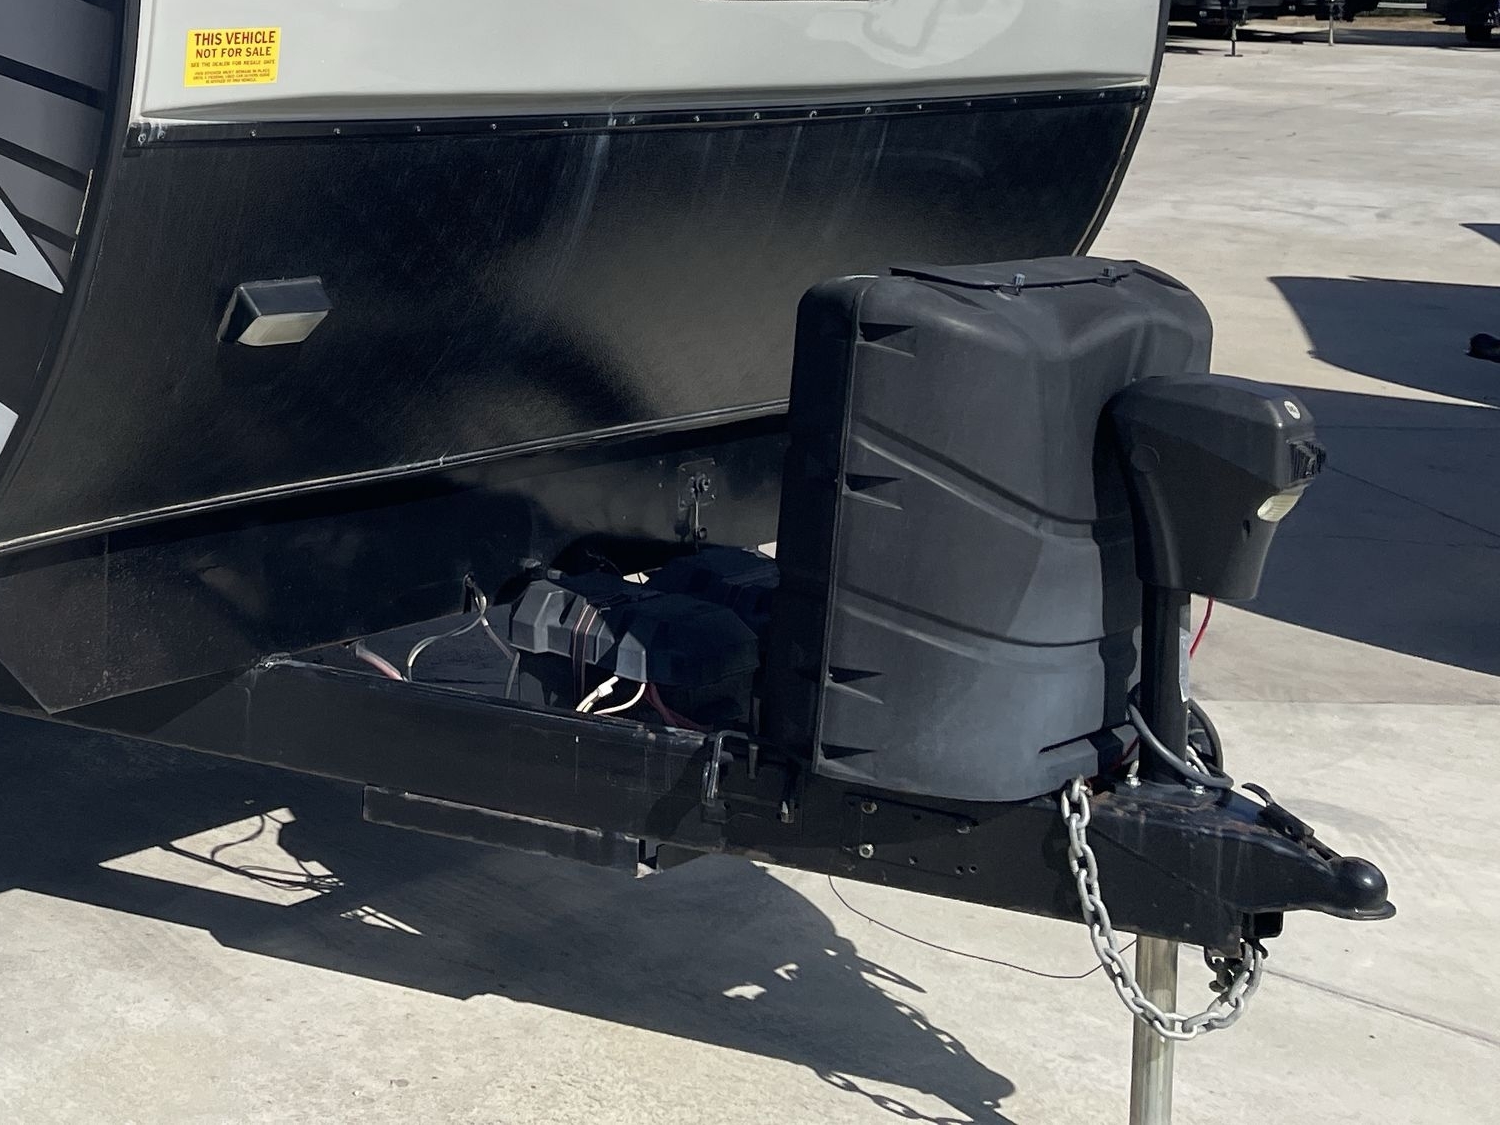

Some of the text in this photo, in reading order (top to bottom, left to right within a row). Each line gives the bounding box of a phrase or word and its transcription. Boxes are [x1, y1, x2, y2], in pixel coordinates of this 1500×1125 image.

[194, 31, 276, 46] THIS VEHICLE
[196, 46, 272, 59] NOT FOR SALE
